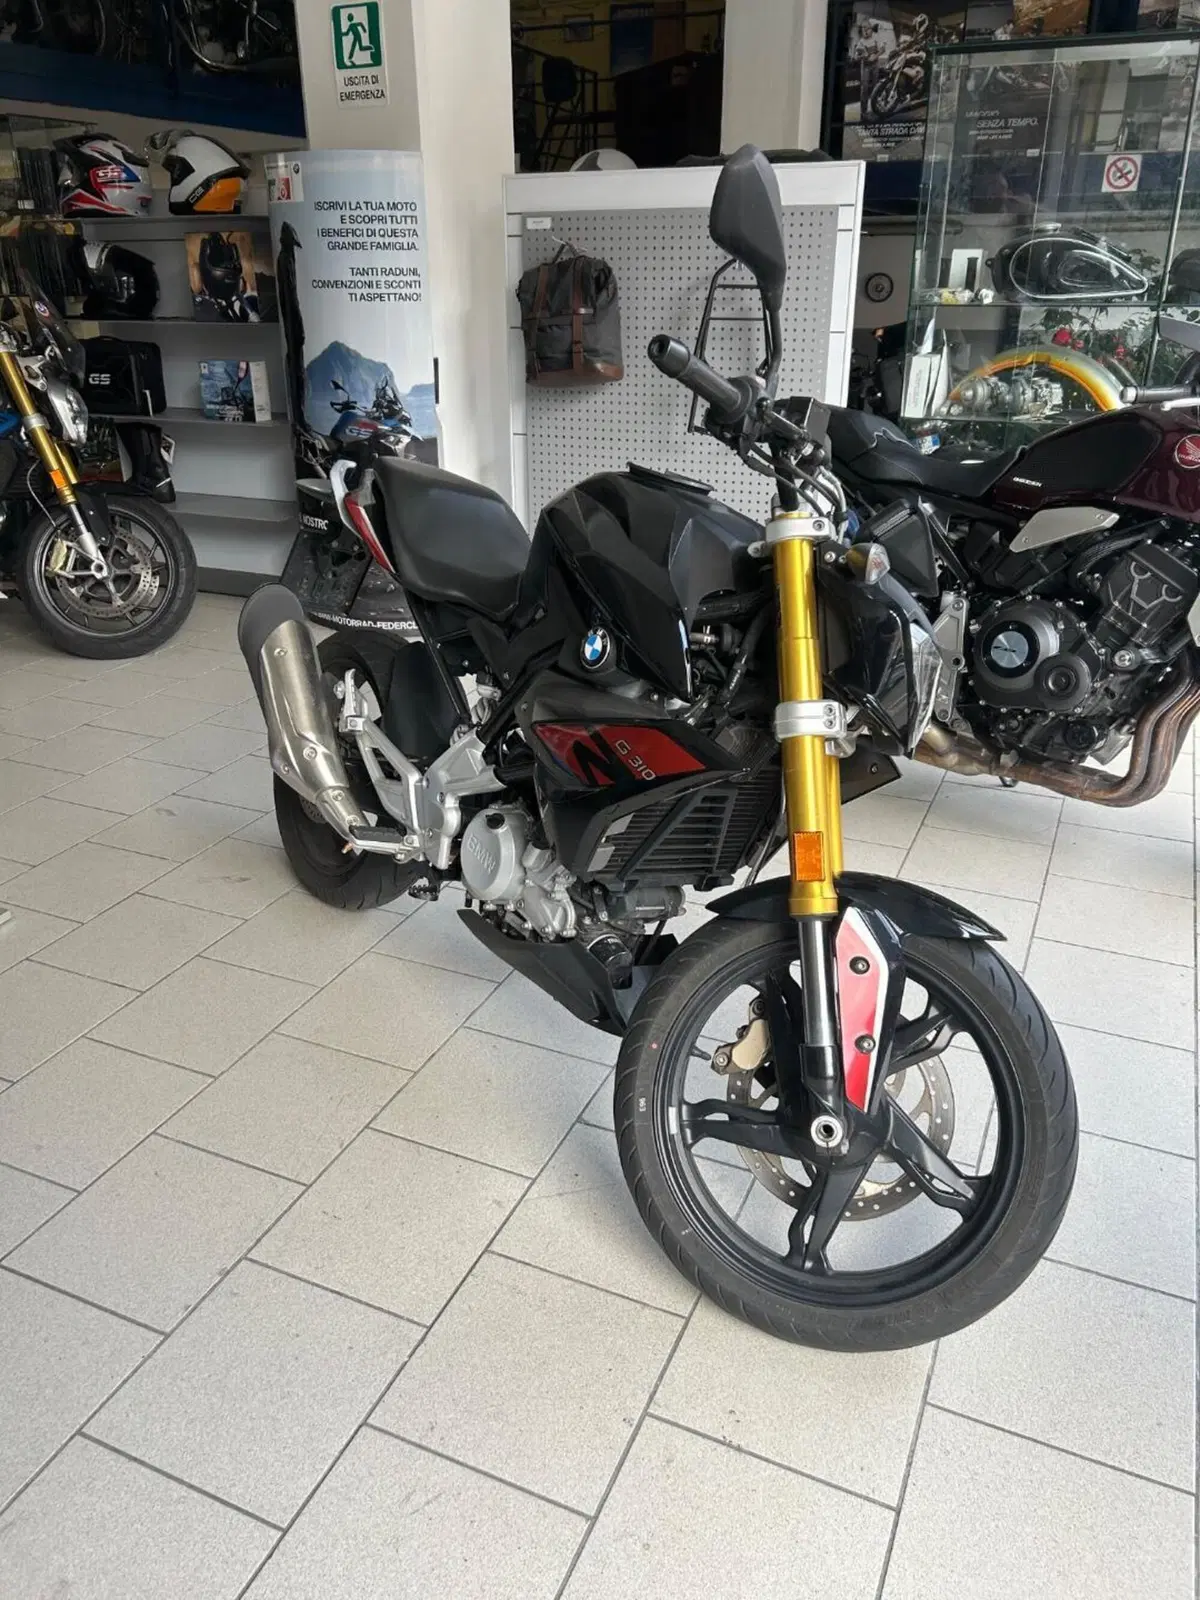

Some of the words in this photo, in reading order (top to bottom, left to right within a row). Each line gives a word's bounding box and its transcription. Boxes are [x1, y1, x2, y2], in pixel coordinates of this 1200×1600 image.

[344, 75, 370, 87] USCITA
[371, 74, 379, 85] DI
[340, 89, 386, 102] EMERGENZA
[314, 201, 347, 211] ISCRIVI
[349, 202, 363, 211] LA
[365, 202, 385, 211] TUA
[387, 202, 417, 211] MOTO
[340, 215, 348, 224] E
[349, 215, 387, 225] SCOPRI
[389, 215, 418, 224] TUTTI
[321, 228, 364, 238] BENEFICI
[366, 228, 376, 238] DI
[378, 228, 418, 238] QUESTA
[327, 241, 368, 251] GRANDE
[370, 241, 419, 251] FAMIGLIA.
[350, 267, 379, 277] TANTI
[380, 267, 420, 277] RADUNI,
[312, 280, 375, 289] CONVENZIONI
[376, 280, 382, 289] E
[384, 279, 421, 289] SCONTI
[348, 292, 358, 302] TI
[359, 292, 422, 302] ASPETTANO!
[88, 373, 111, 385] GS
[615, 739, 631, 755] G
[628, 755, 656, 781] 310
[467, 833, 497, 875] BMW
